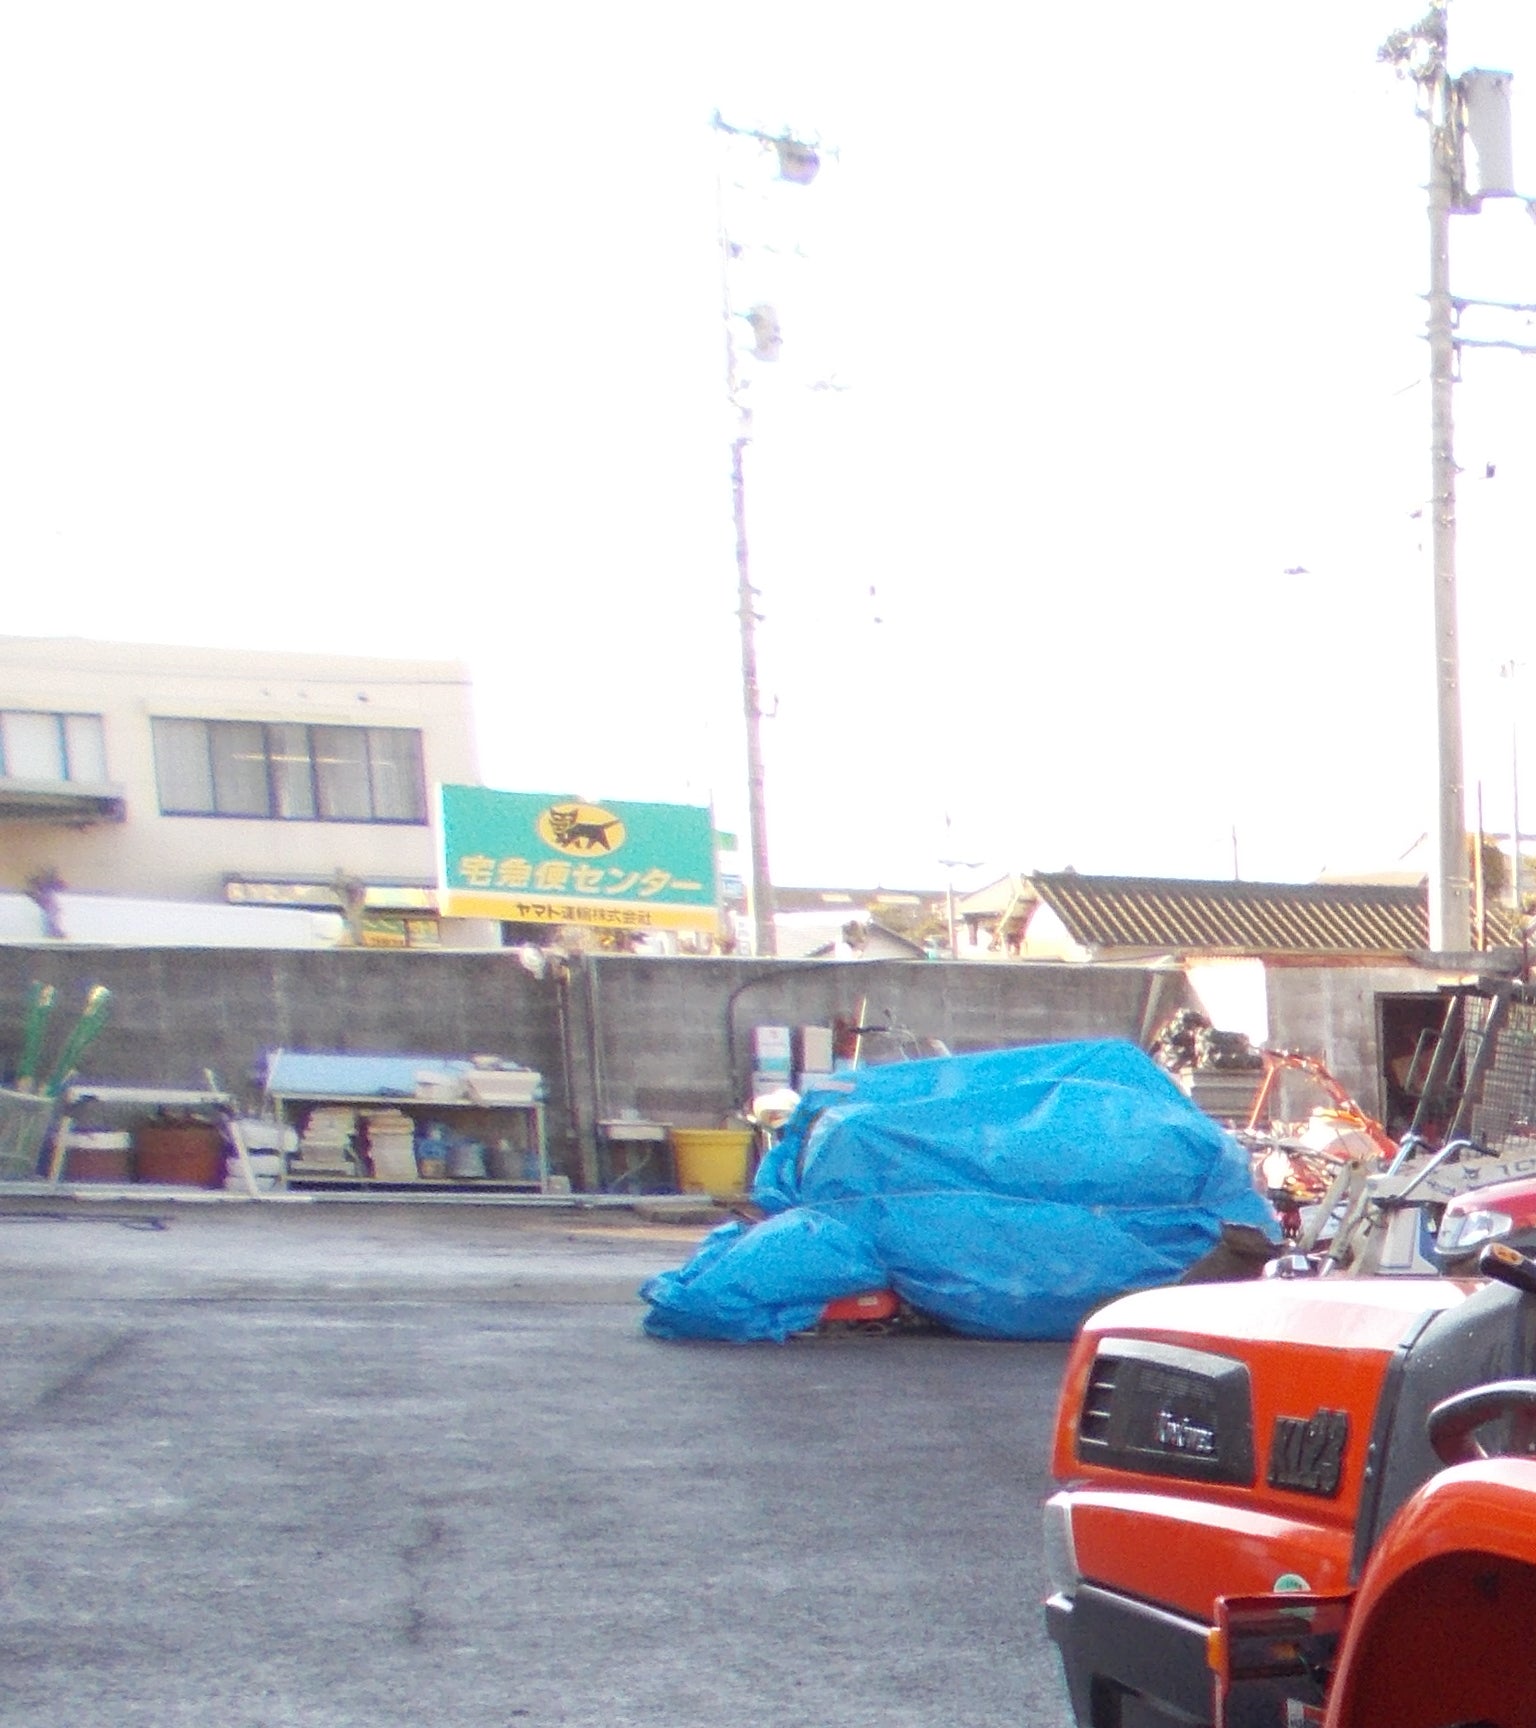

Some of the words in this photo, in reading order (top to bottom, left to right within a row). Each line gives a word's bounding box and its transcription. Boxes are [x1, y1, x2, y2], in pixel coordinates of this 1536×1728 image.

[459, 855, 702, 897] 宅急便センター
[516, 902, 653, 926] ヤマト運輸株式会社
